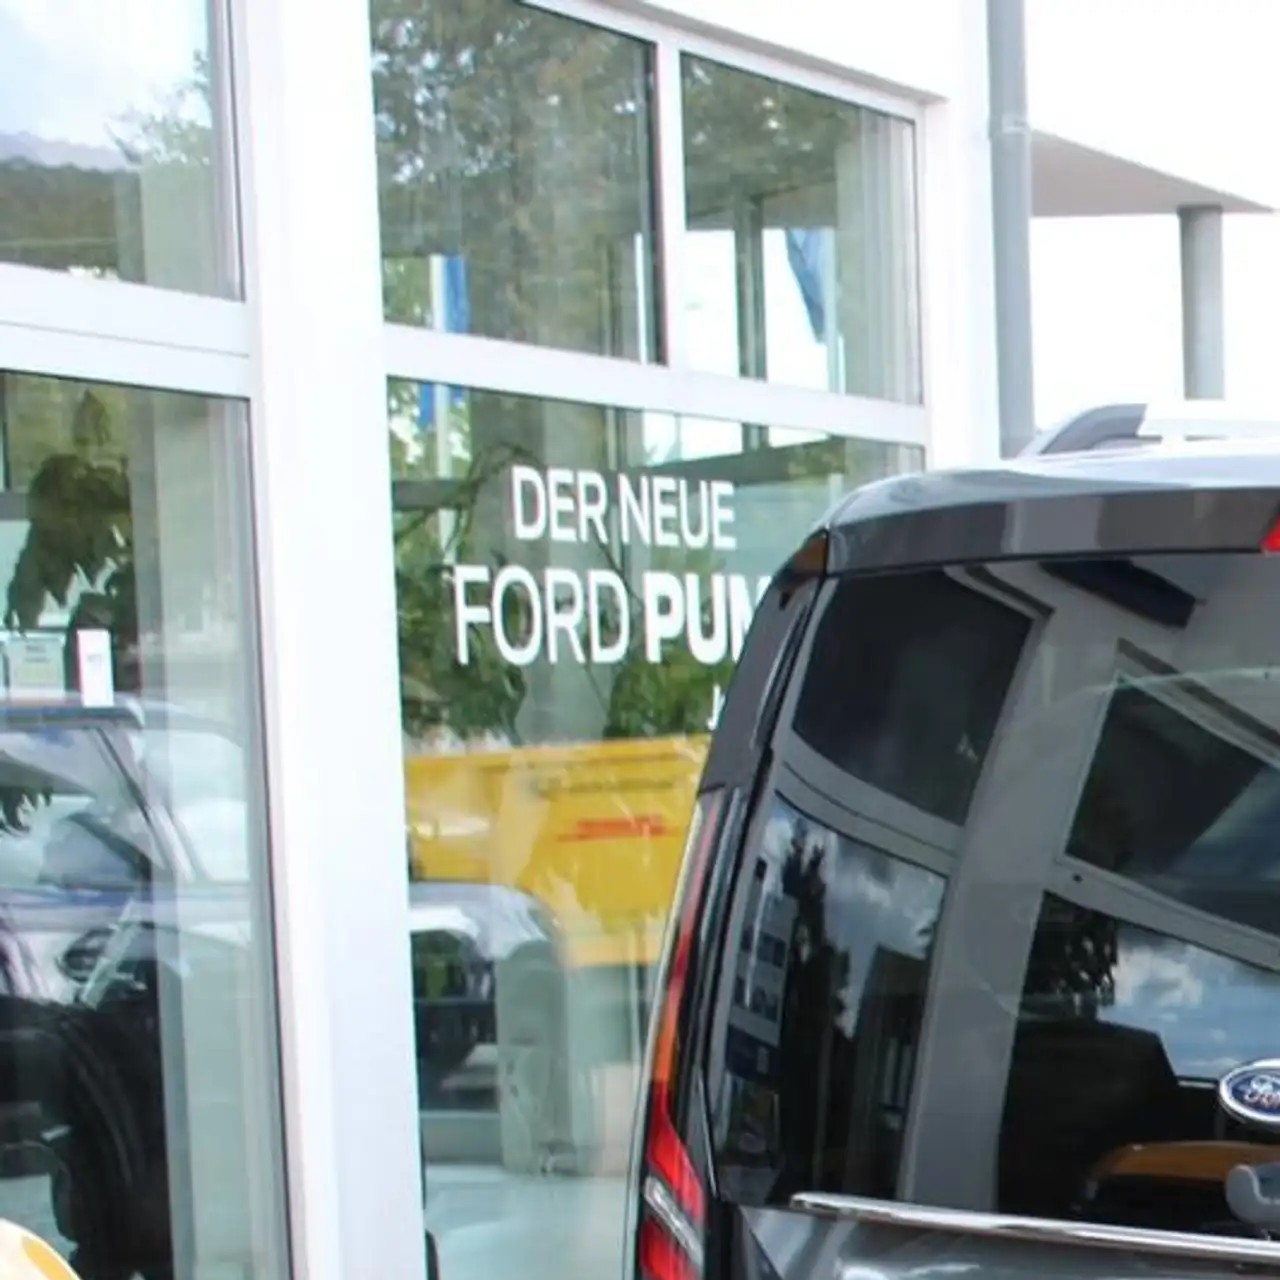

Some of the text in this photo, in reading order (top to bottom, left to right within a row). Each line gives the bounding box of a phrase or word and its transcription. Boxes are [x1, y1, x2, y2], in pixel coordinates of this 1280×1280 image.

[511, 464, 737, 551] DER NEUE
[453, 564, 631, 666] FORD
